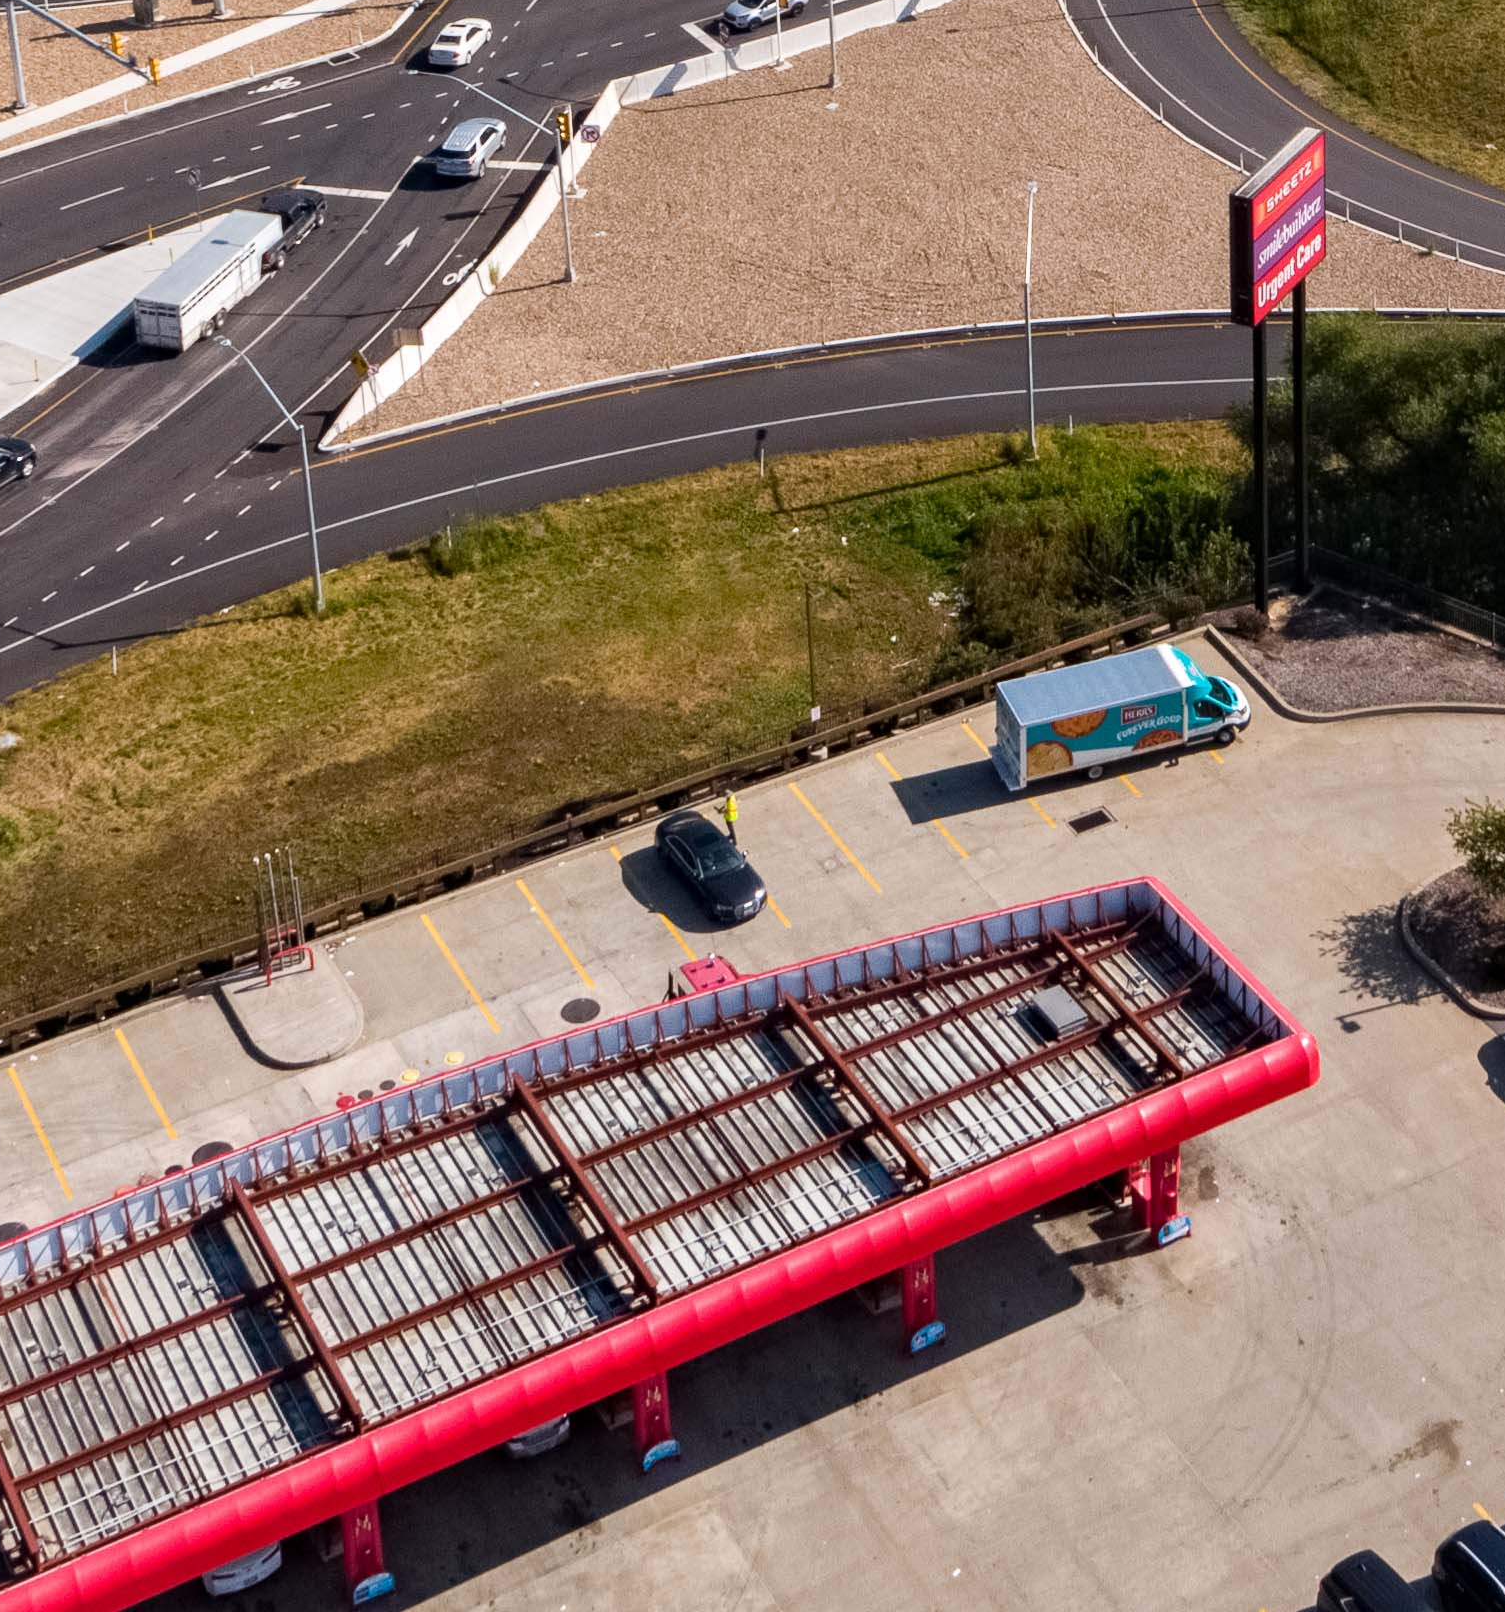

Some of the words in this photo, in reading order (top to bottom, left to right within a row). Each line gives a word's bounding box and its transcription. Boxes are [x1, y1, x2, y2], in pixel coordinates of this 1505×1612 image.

[1266, 160, 1312, 213] SHEETZ
[1258, 195, 1322, 269] smilebuilderz
[1257, 256, 1296, 308] Urgent
[1296, 234, 1322, 269] Care
[1156, 714, 1182, 726] GOOD
